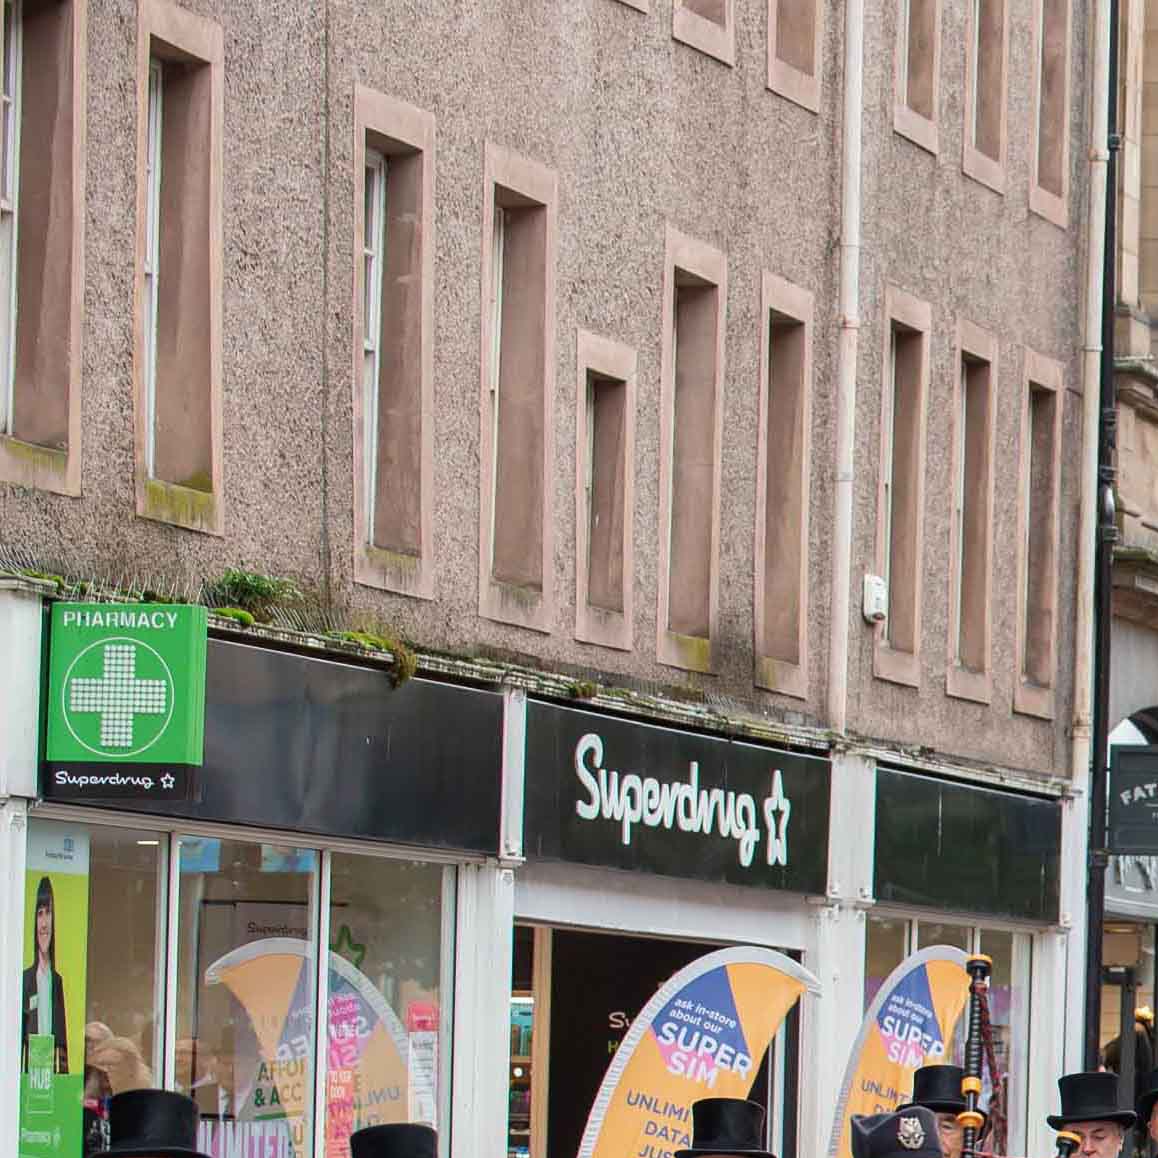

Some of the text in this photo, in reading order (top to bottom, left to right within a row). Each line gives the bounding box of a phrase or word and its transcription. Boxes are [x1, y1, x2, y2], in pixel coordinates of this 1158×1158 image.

[63, 611, 178, 629] PHARMACY
[55, 770, 155, 789] Superdrug
[575, 733, 760, 867] Superdrug
[669, 1009, 723, 1034] about our
[674, 998, 737, 1029] ask in-store
[657, 1022, 753, 1081] SUPER
[881, 1015, 945, 1057] SUPER
[666, 1050, 719, 1089] SIM
[888, 1040, 924, 1069] SIM
[626, 1088, 690, 1122] UNLIMI
